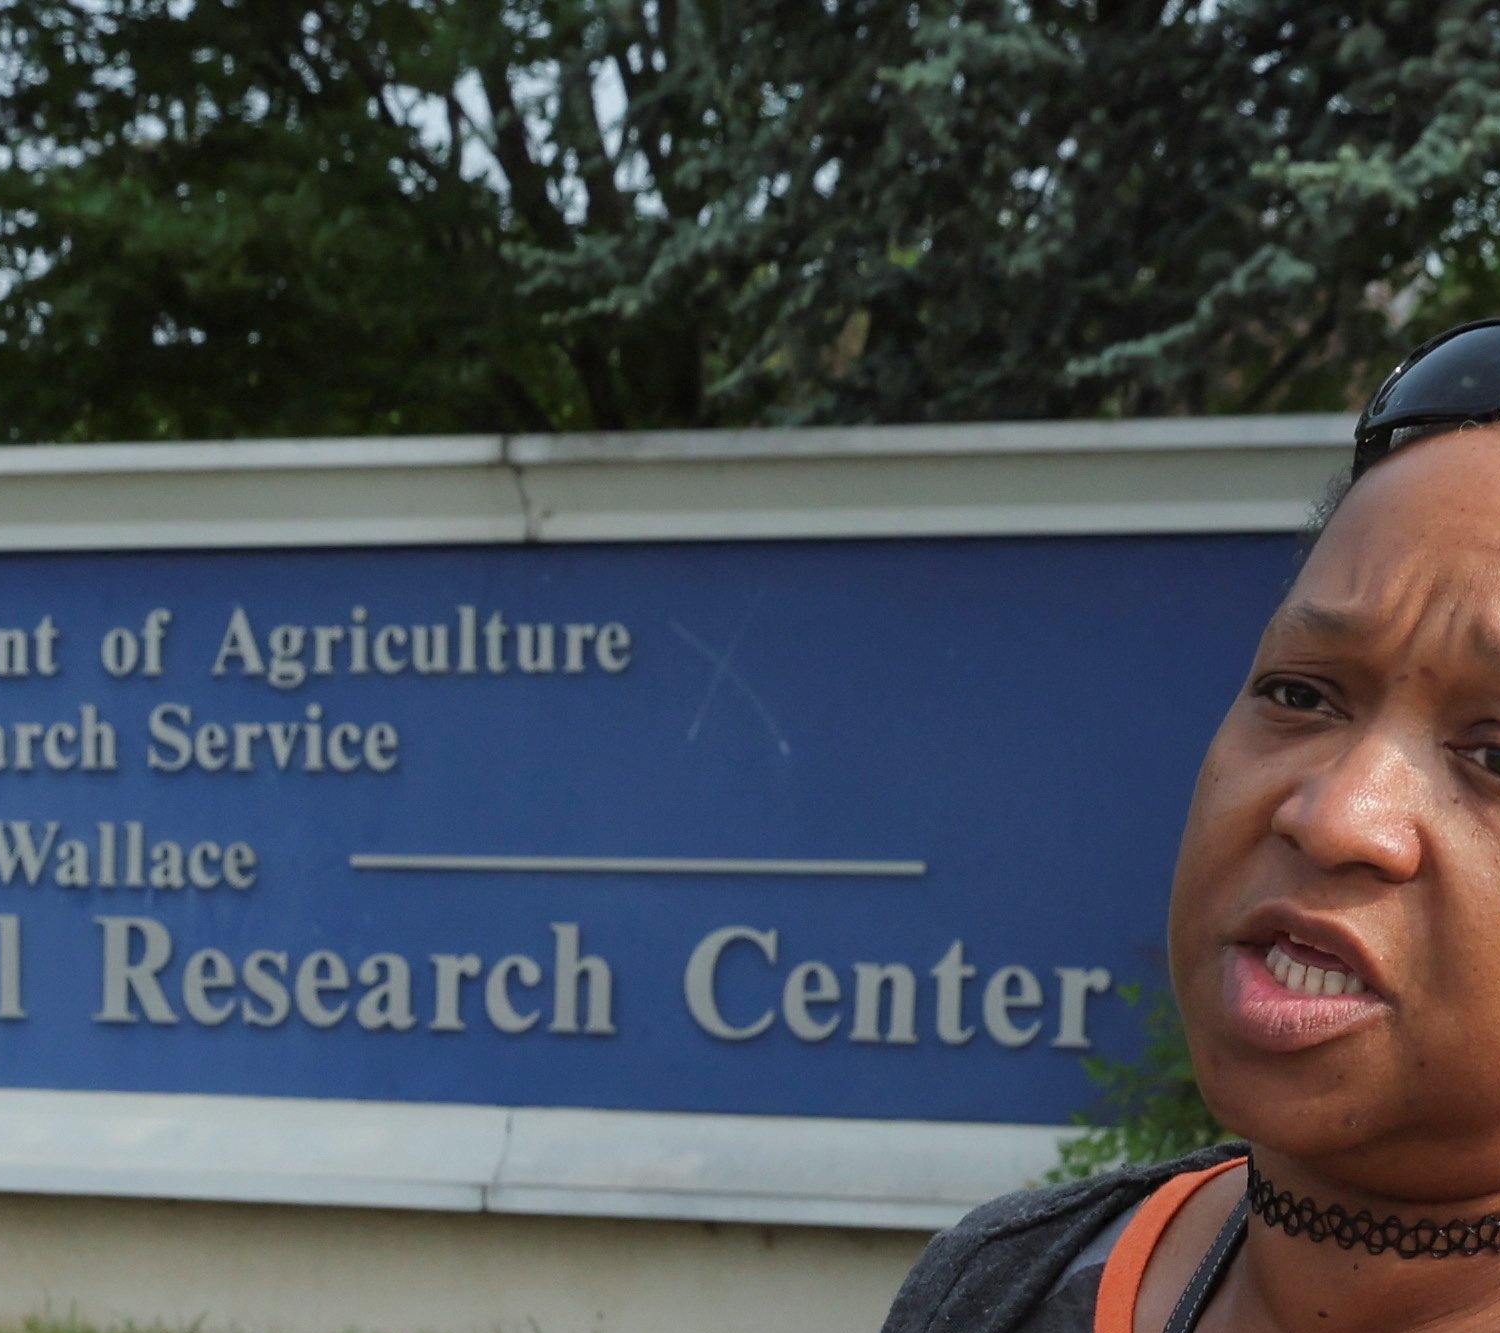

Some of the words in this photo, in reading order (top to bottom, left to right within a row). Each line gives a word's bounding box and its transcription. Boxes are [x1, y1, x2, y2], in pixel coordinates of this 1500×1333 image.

[101, 608, 171, 676] of
[212, 606, 632, 688] Agriculture
[146, 702, 399, 771] Service
[93, 915, 618, 1034] Research
[683, 924, 1112, 1048] Center
